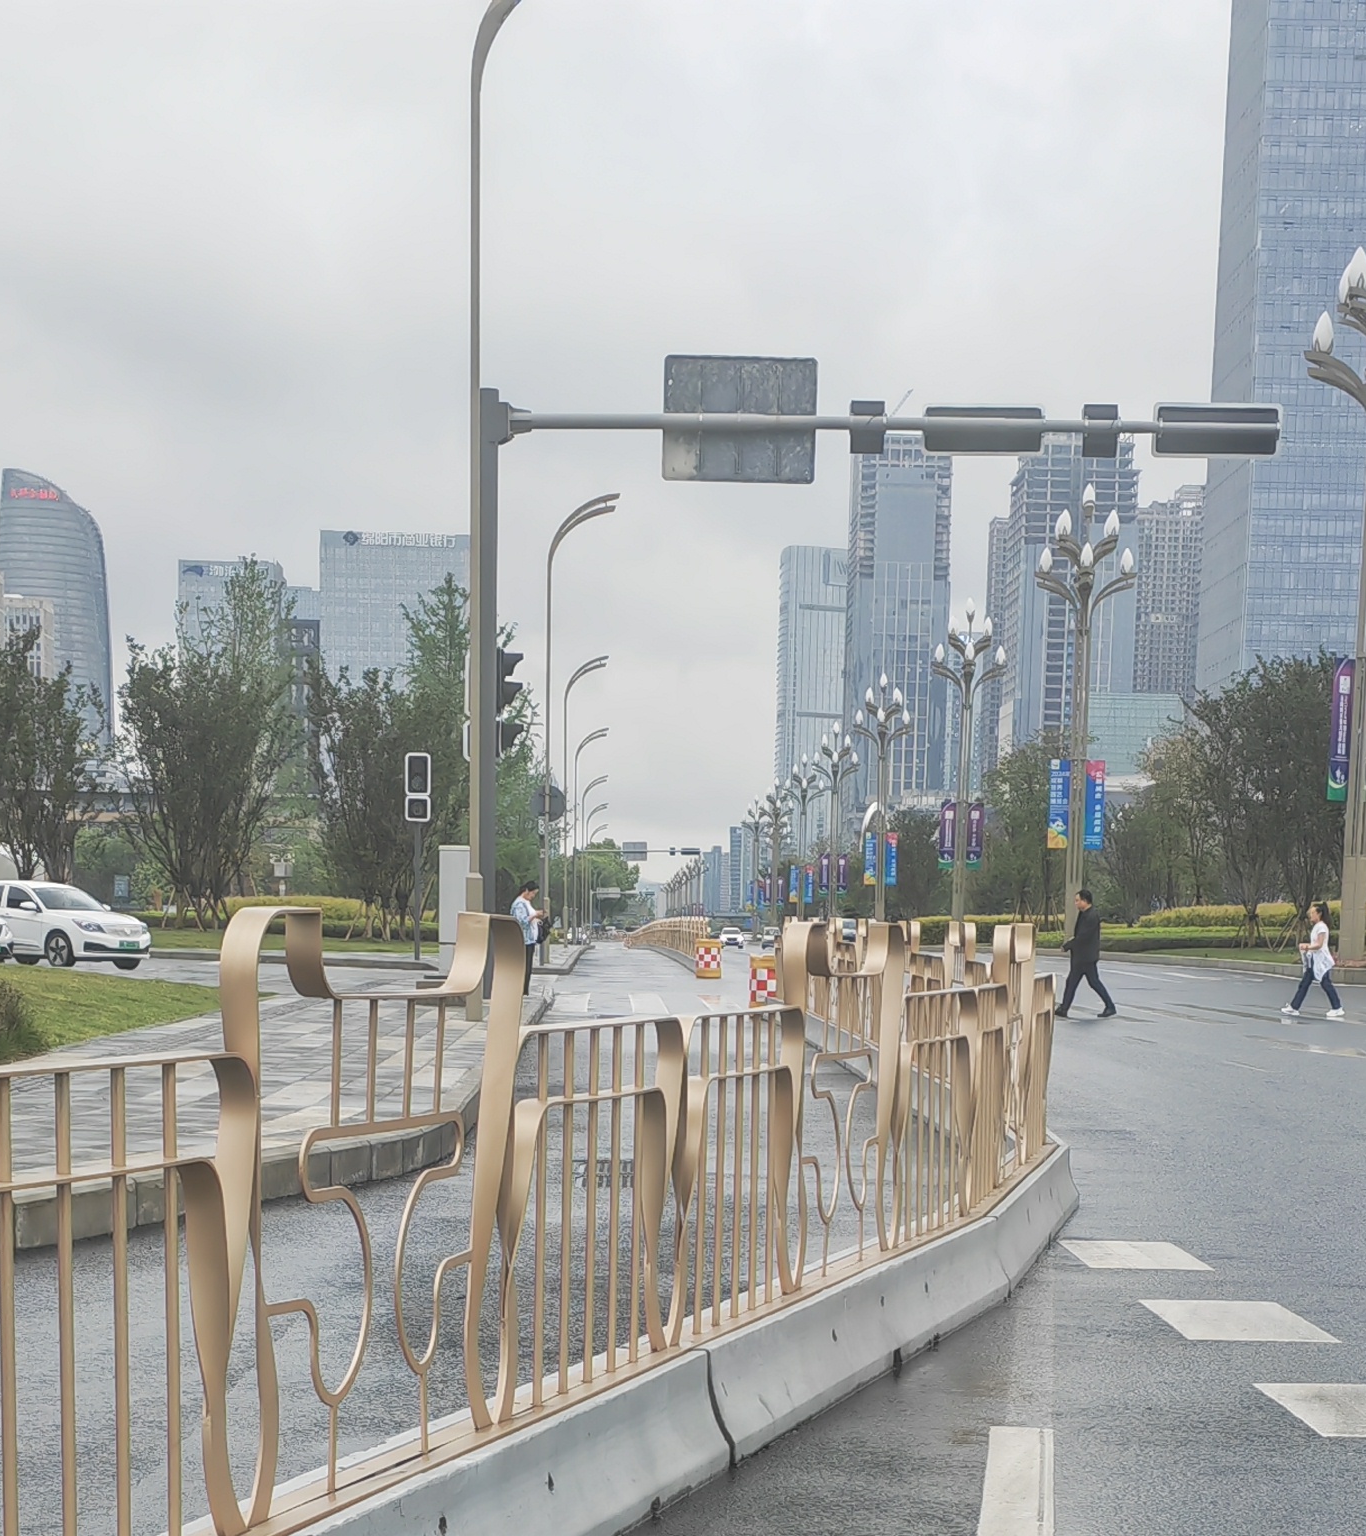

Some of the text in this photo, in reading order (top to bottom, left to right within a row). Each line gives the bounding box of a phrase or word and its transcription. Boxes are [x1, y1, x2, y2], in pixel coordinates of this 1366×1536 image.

[361, 531, 456, 548] 绵阳市商业银行
